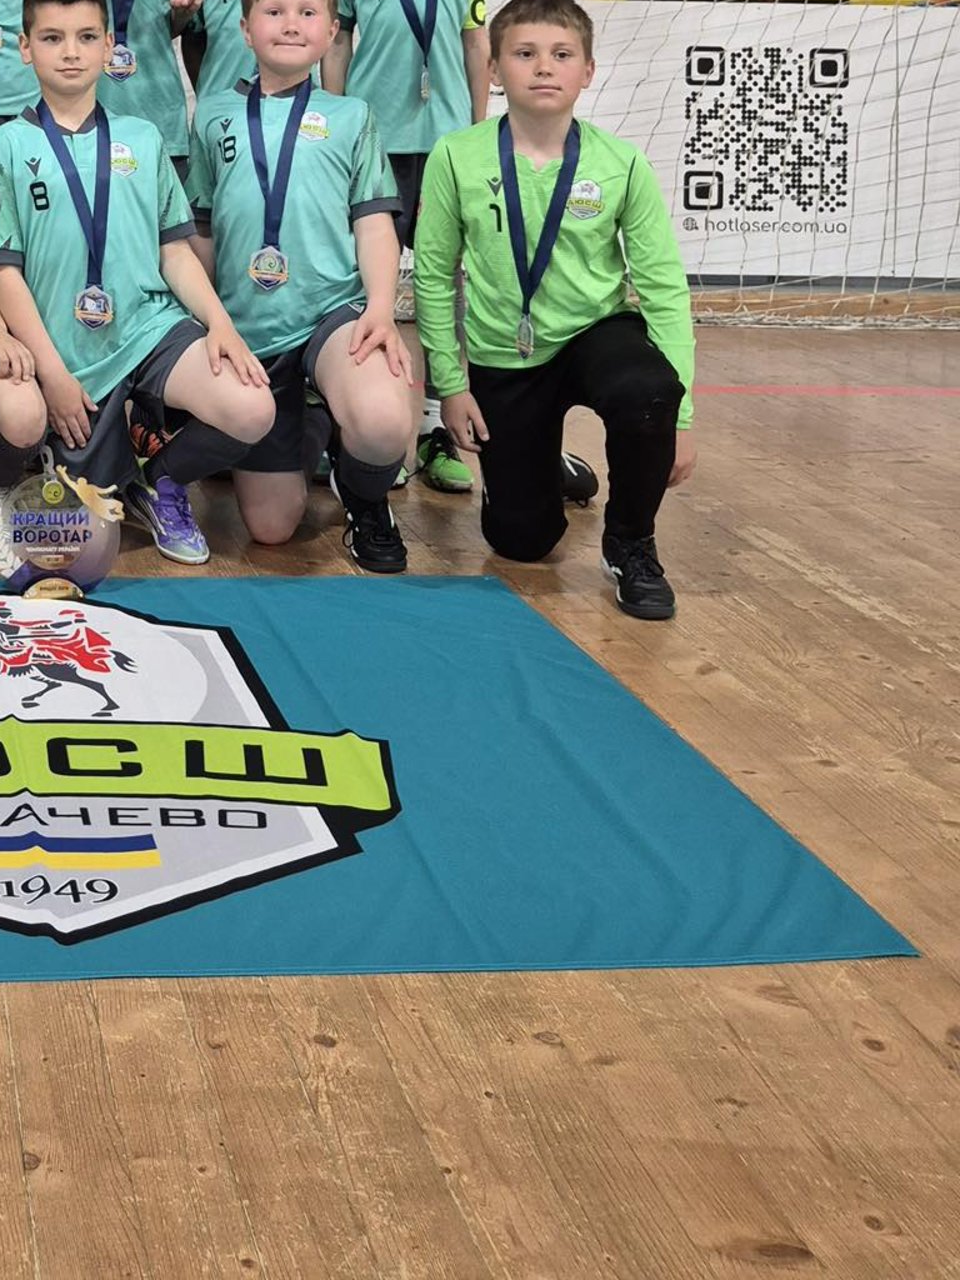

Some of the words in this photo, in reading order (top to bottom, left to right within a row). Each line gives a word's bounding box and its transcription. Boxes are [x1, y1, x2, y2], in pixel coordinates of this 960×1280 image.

[30, 181, 50, 210] 8
[489, 203, 502, 232] 1
[704, 217, 847, 233] hotlaser.com.ua
[13, 530, 93, 543] ВОРОТАР
[0, 874, 120, 904] 1949
